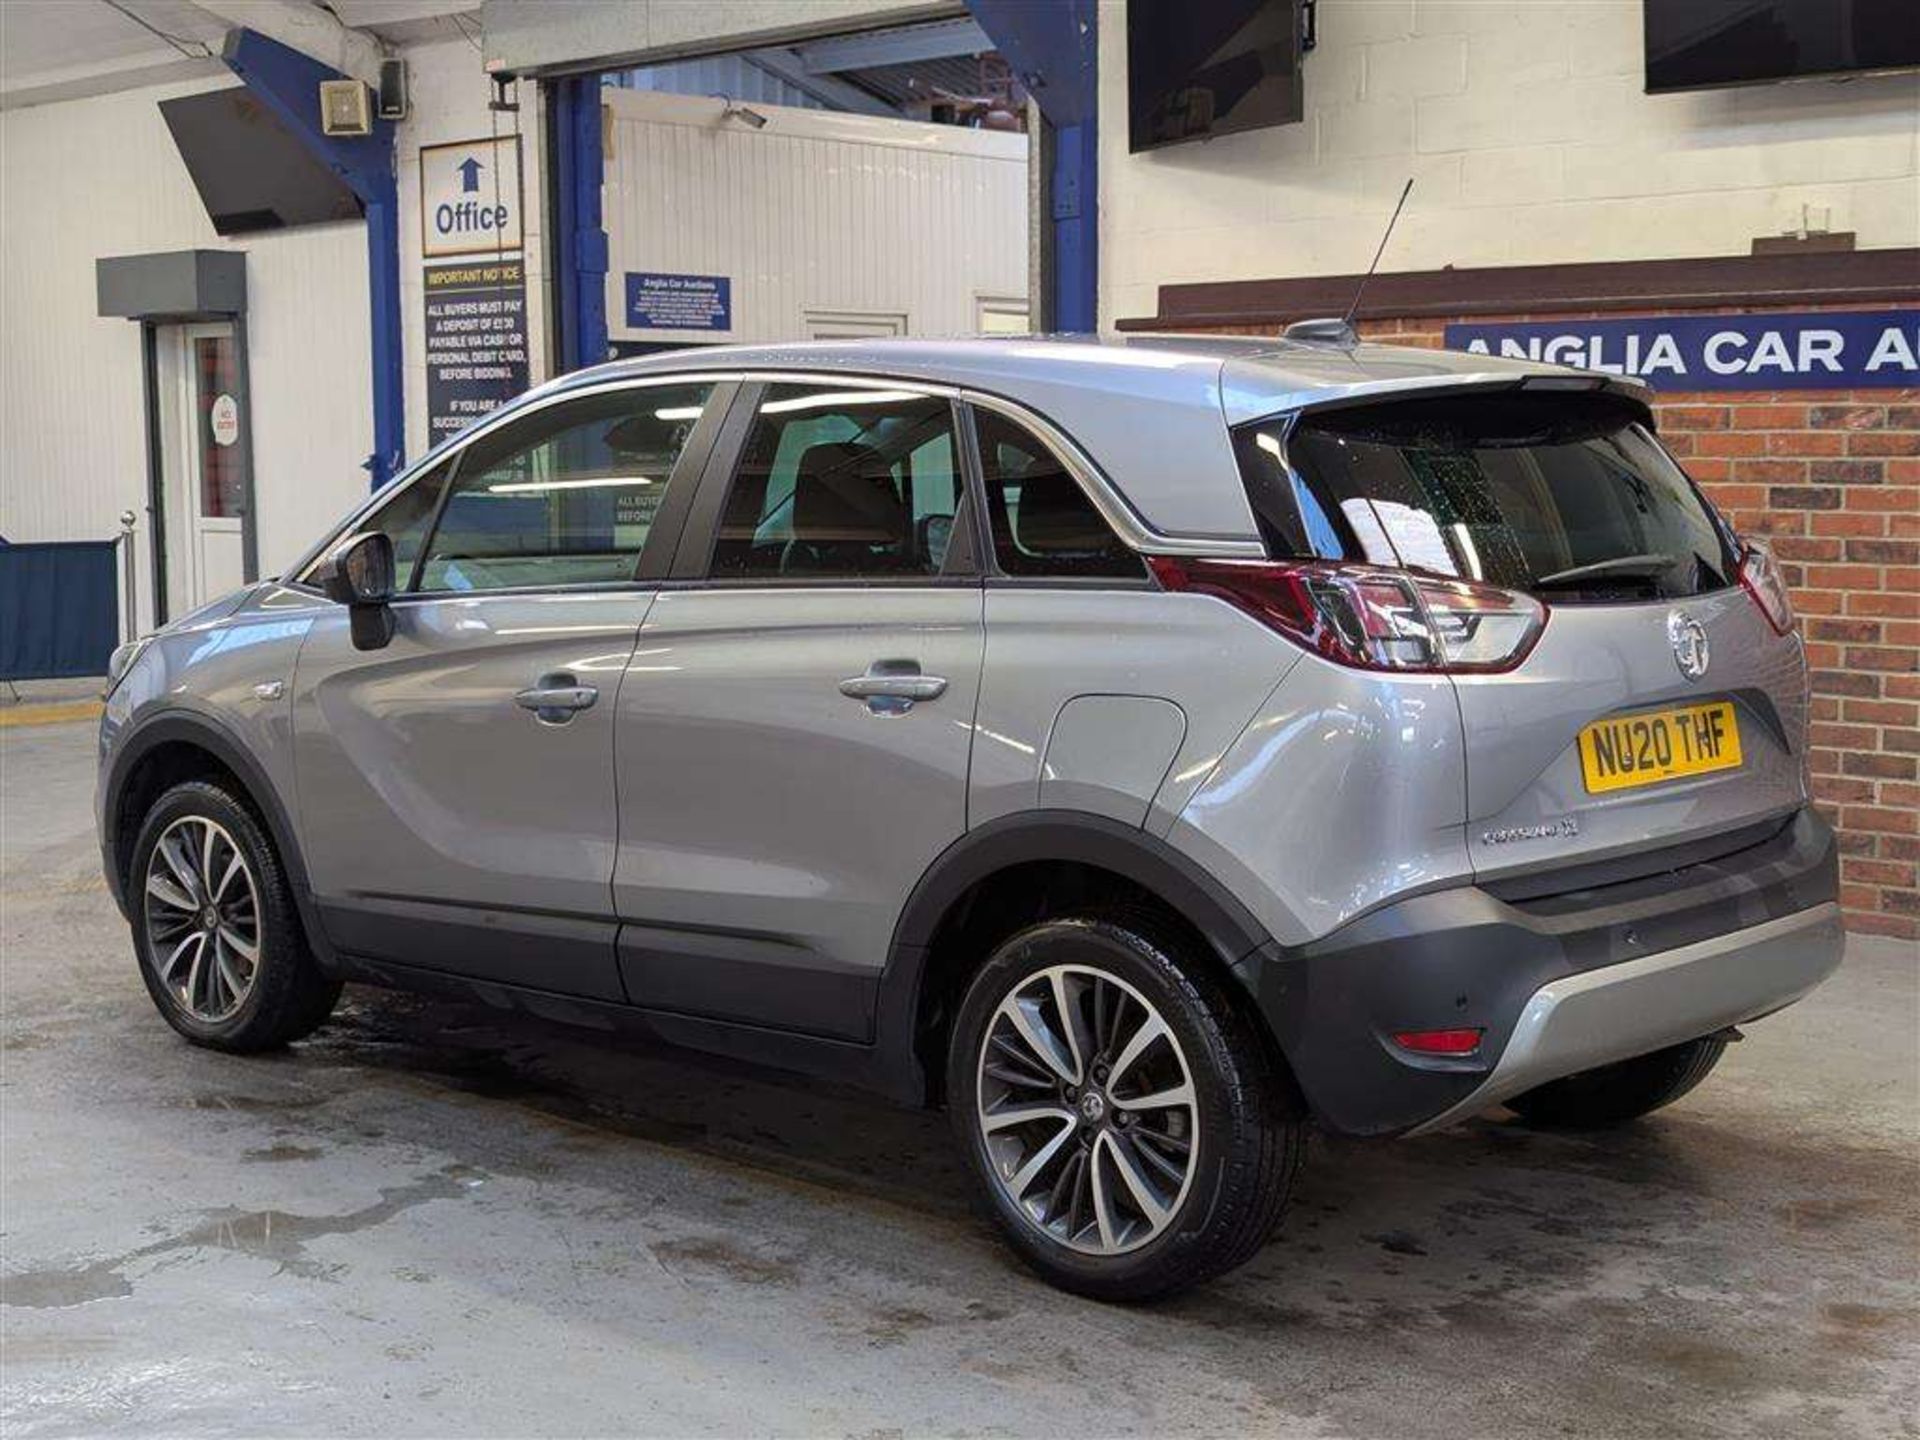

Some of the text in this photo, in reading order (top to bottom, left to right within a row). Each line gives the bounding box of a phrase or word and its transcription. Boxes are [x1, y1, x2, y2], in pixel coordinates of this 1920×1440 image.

[436, 201, 508, 234] Office
[429, 270, 481, 285] IMPORTANT
[644, 278, 668, 290] Anglia
[669, 278, 682, 288] Car
[428, 299, 523, 316] ALL BUYERS MUST PAY
[436, 320, 442, 332] A
[443, 318, 479, 332] DEPOSIT
[479, 318, 492, 330] OF
[429, 334, 467, 348] PAYABLE
[467, 334, 482, 347] VIA
[508, 332, 524, 345] OR
[427, 351, 471, 365] PERSONAL
[471, 351, 497, 363] DEBIT
[1704, 330, 1845, 374] CAR
[1865, 327, 1920, 371] A
[439, 367, 473, 381] BEFORE
[449, 400, 458, 412] IF
[458, 399, 477, 412] YOU
[479, 398, 495, 411] ARE
[1592, 709, 1724, 777] NU20 THF
